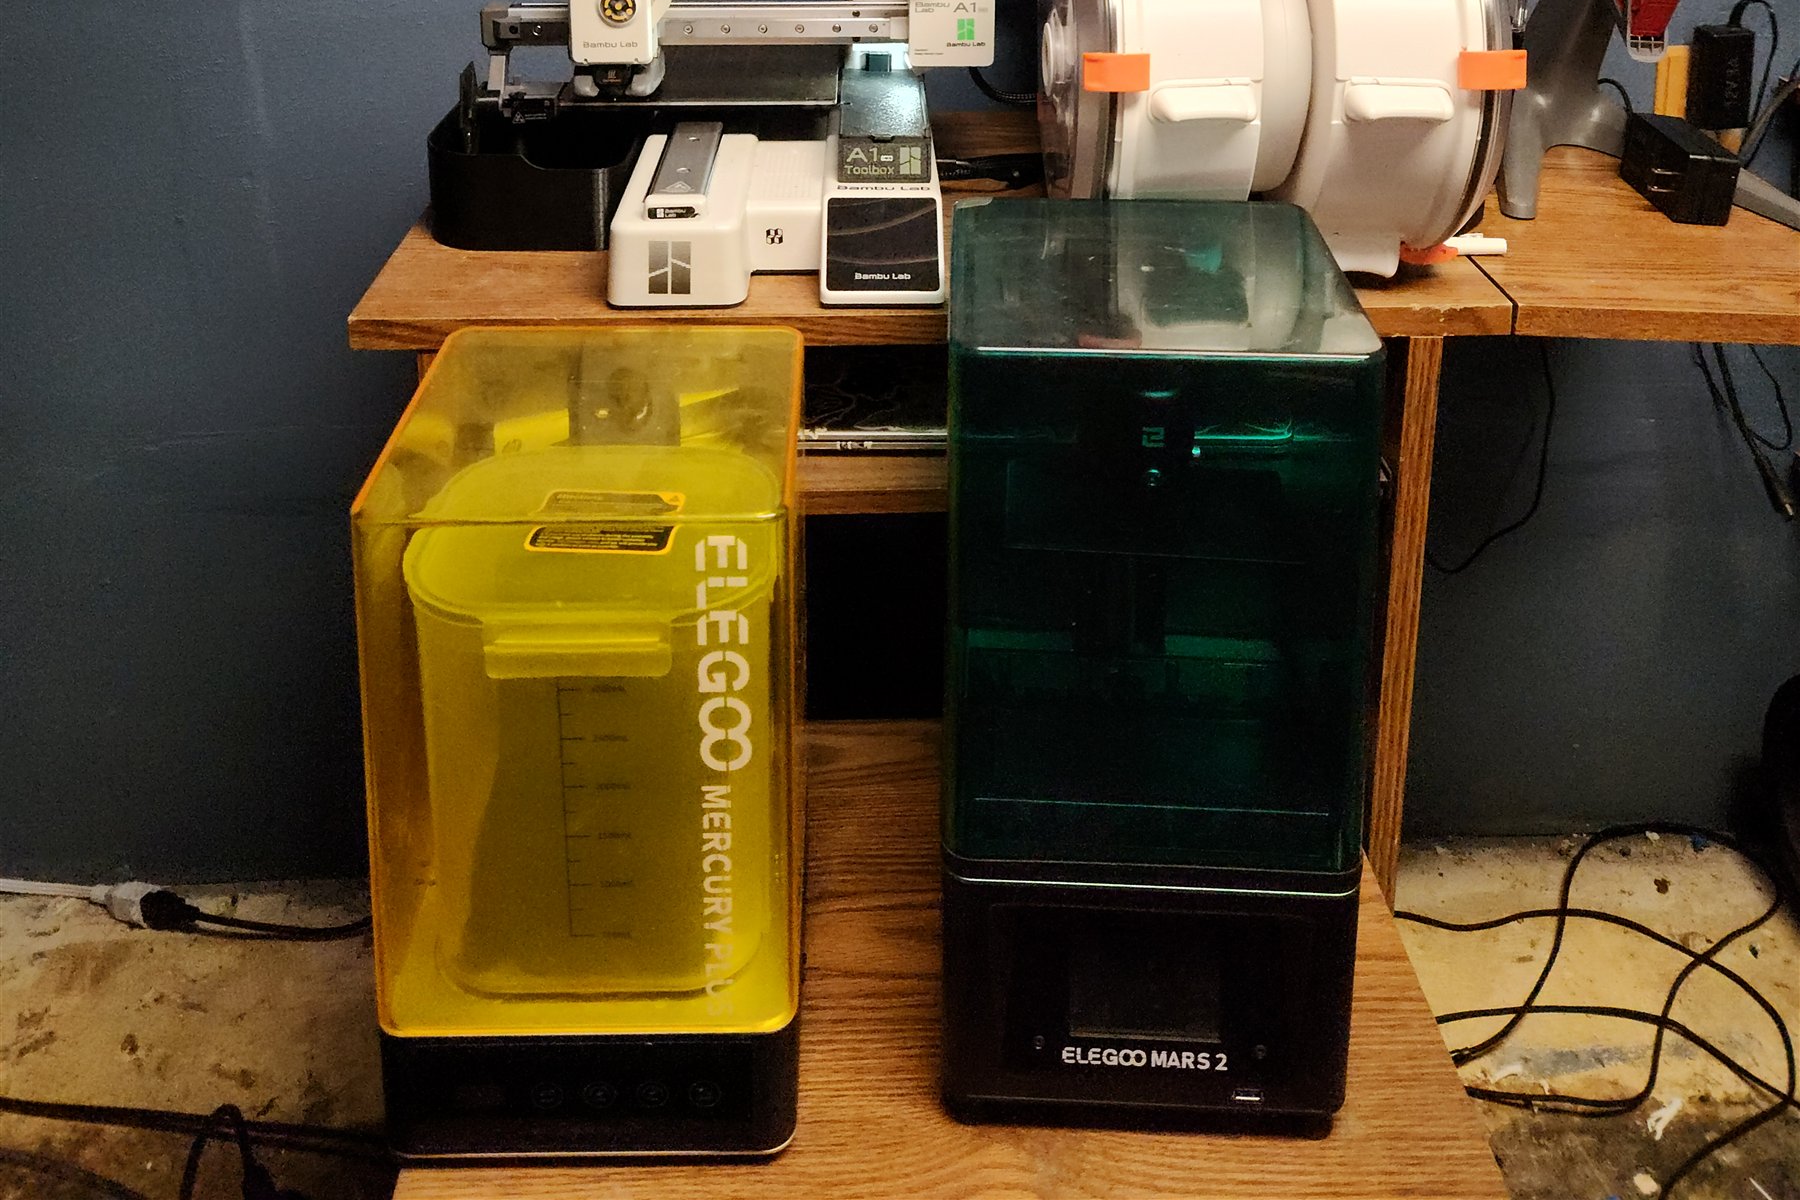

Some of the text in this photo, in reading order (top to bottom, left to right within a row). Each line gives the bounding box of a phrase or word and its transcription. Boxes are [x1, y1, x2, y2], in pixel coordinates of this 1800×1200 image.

[953, 2, 977, 13] A1
[583, 41, 618, 49] Bambu
[846, 147, 879, 163] A1
[844, 164, 895, 175] Toolbox
[854, 272, 912, 280] Bambu Lab
[694, 535, 753, 1017] ELEGOO MERCURY PLUS
[1061, 1046, 1228, 1071] ELEGOO MARS 2
